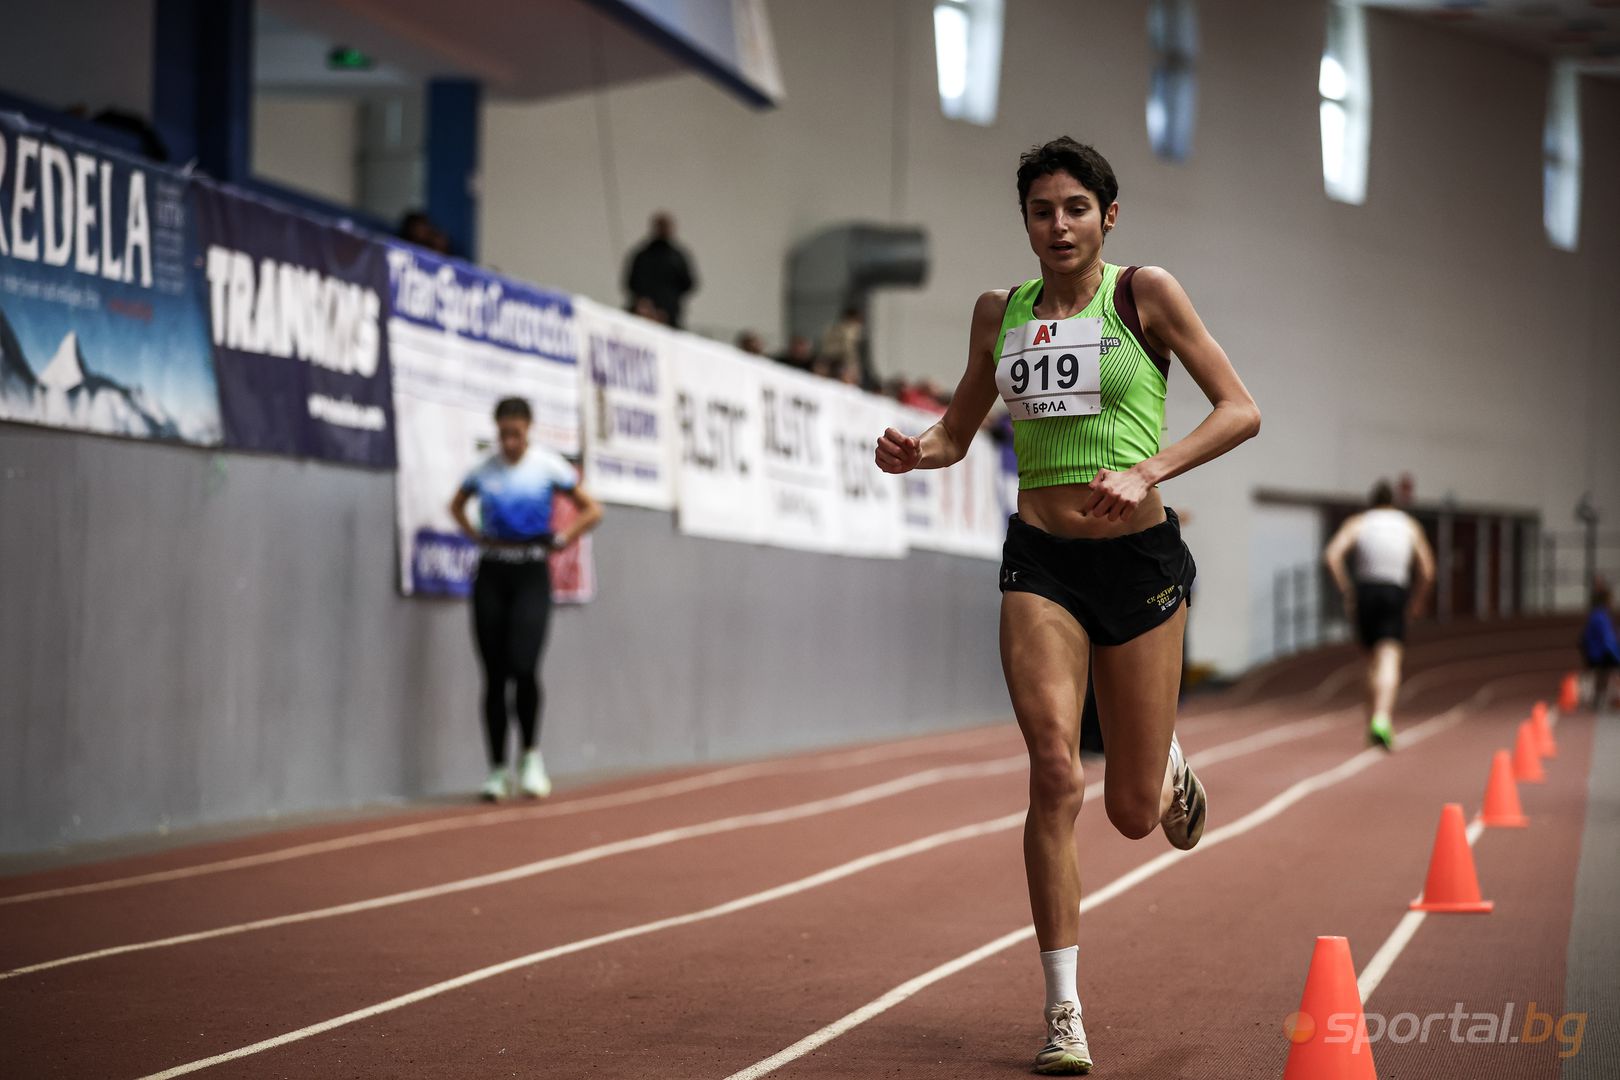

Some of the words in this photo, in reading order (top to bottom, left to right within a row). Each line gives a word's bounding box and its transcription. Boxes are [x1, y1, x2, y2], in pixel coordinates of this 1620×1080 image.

[1100, 338, 1120, 346] ТИВ
[1010, 353, 1079, 395] 919
[1033, 400, 1067, 414] БФЛА
